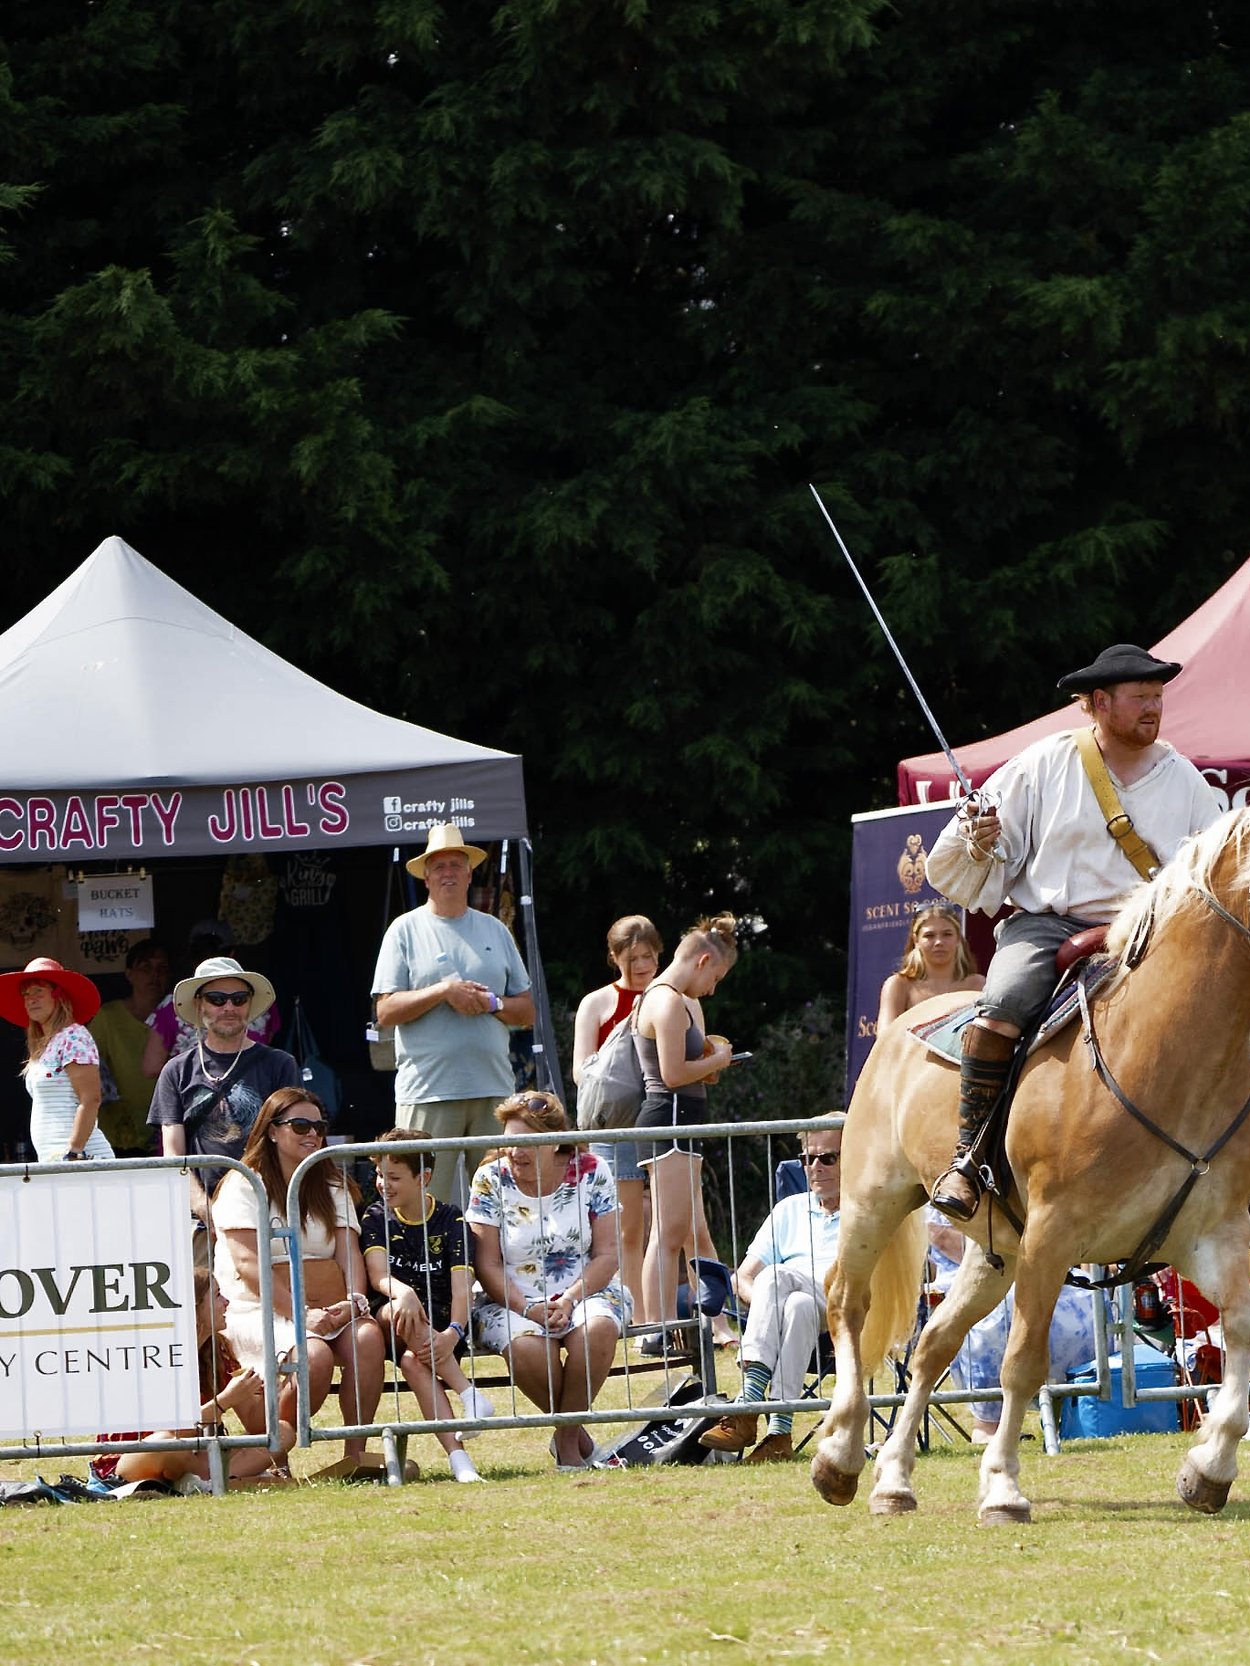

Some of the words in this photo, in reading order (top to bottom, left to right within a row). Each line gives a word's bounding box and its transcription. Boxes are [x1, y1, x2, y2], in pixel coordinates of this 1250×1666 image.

[403, 800, 446, 813] crafty
[450, 798, 475, 812] jills
[0, 793, 181, 850] CRAFTY
[208, 782, 350, 842] JILL'S
[91, 888, 140, 900] BUCKET
[100, 907, 133, 918] HATS
[866, 903, 899, 919] SCENT
[0, 1261, 182, 1318] OVER
[35, 1344, 184, 1375] CENTRE
